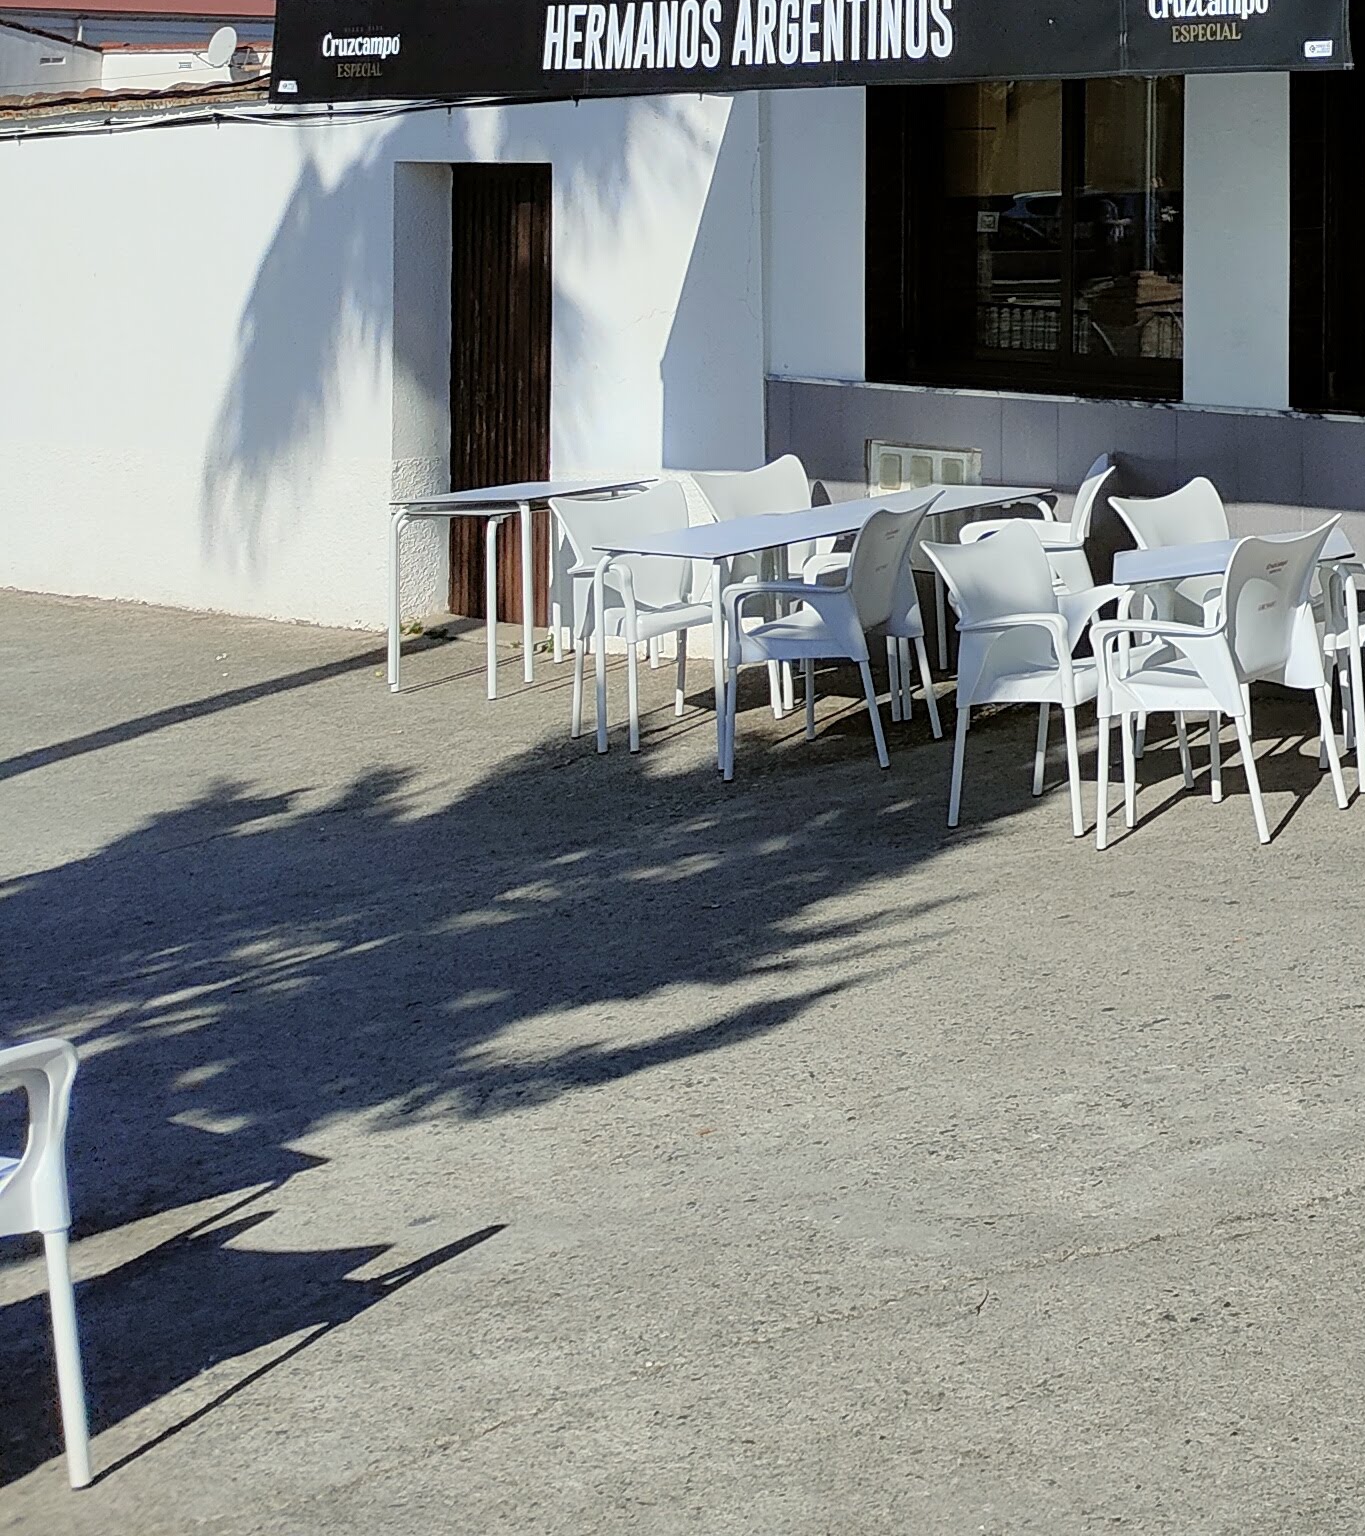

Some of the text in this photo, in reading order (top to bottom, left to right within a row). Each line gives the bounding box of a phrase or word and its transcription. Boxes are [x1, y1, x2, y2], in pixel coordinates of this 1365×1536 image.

[1171, 22, 1242, 43] ESPECIAL
[322, 31, 401, 60] Cruzcampo
[337, 62, 383, 78] ESPECIAL
